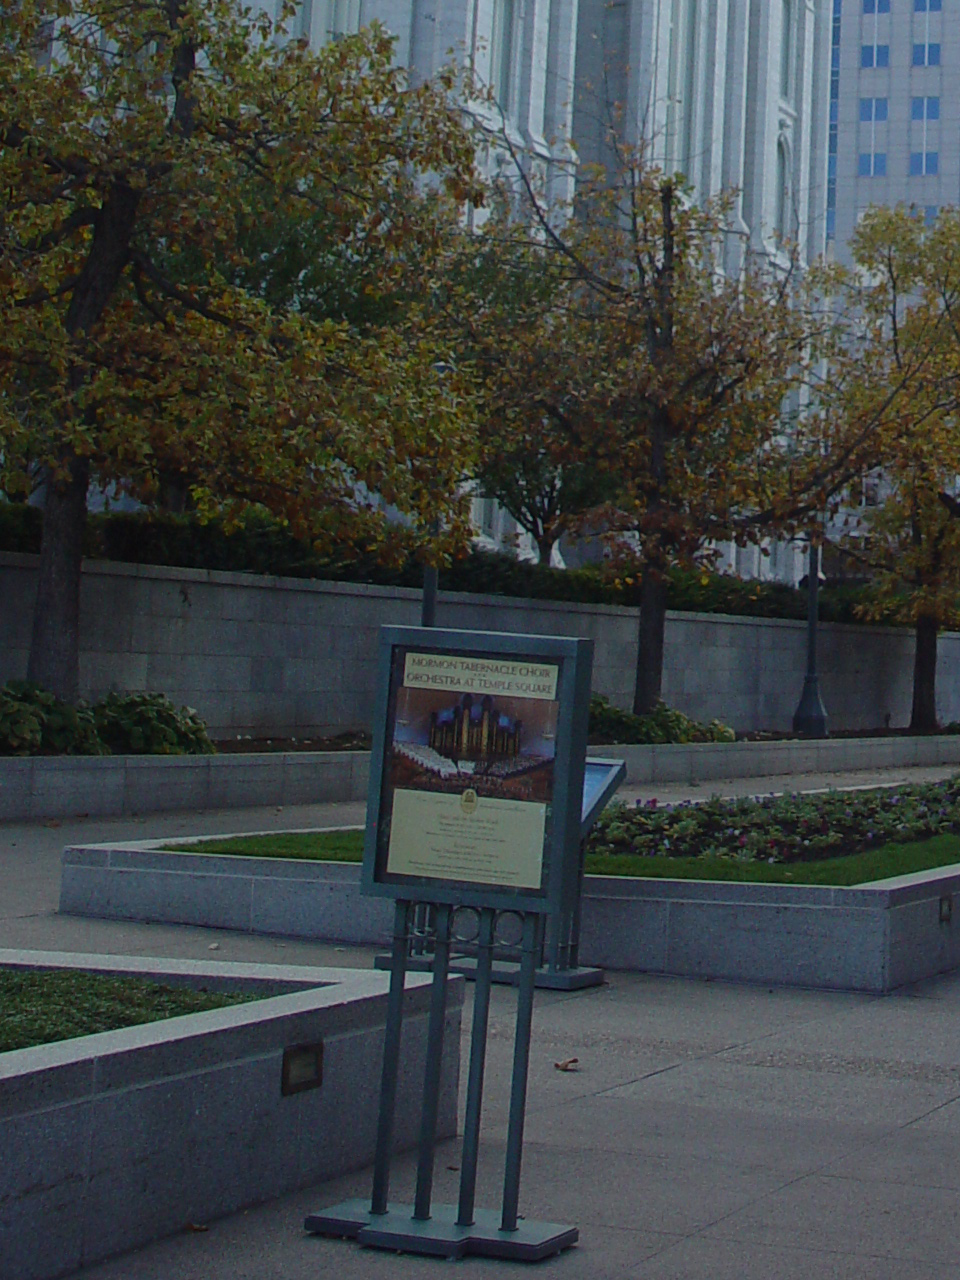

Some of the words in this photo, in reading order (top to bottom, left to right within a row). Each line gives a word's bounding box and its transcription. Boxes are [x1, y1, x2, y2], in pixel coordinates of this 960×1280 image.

[411, 657, 457, 670] MORMON
[460, 661, 516, 676] TABERNACLE
[519, 667, 551, 678] CHOIR
[406, 672, 461, 685] ORCHESTRA
[464, 678, 475, 687] AT
[477, 679, 513, 690] TEMPLE
[515, 682, 552, 694] SQUARE
